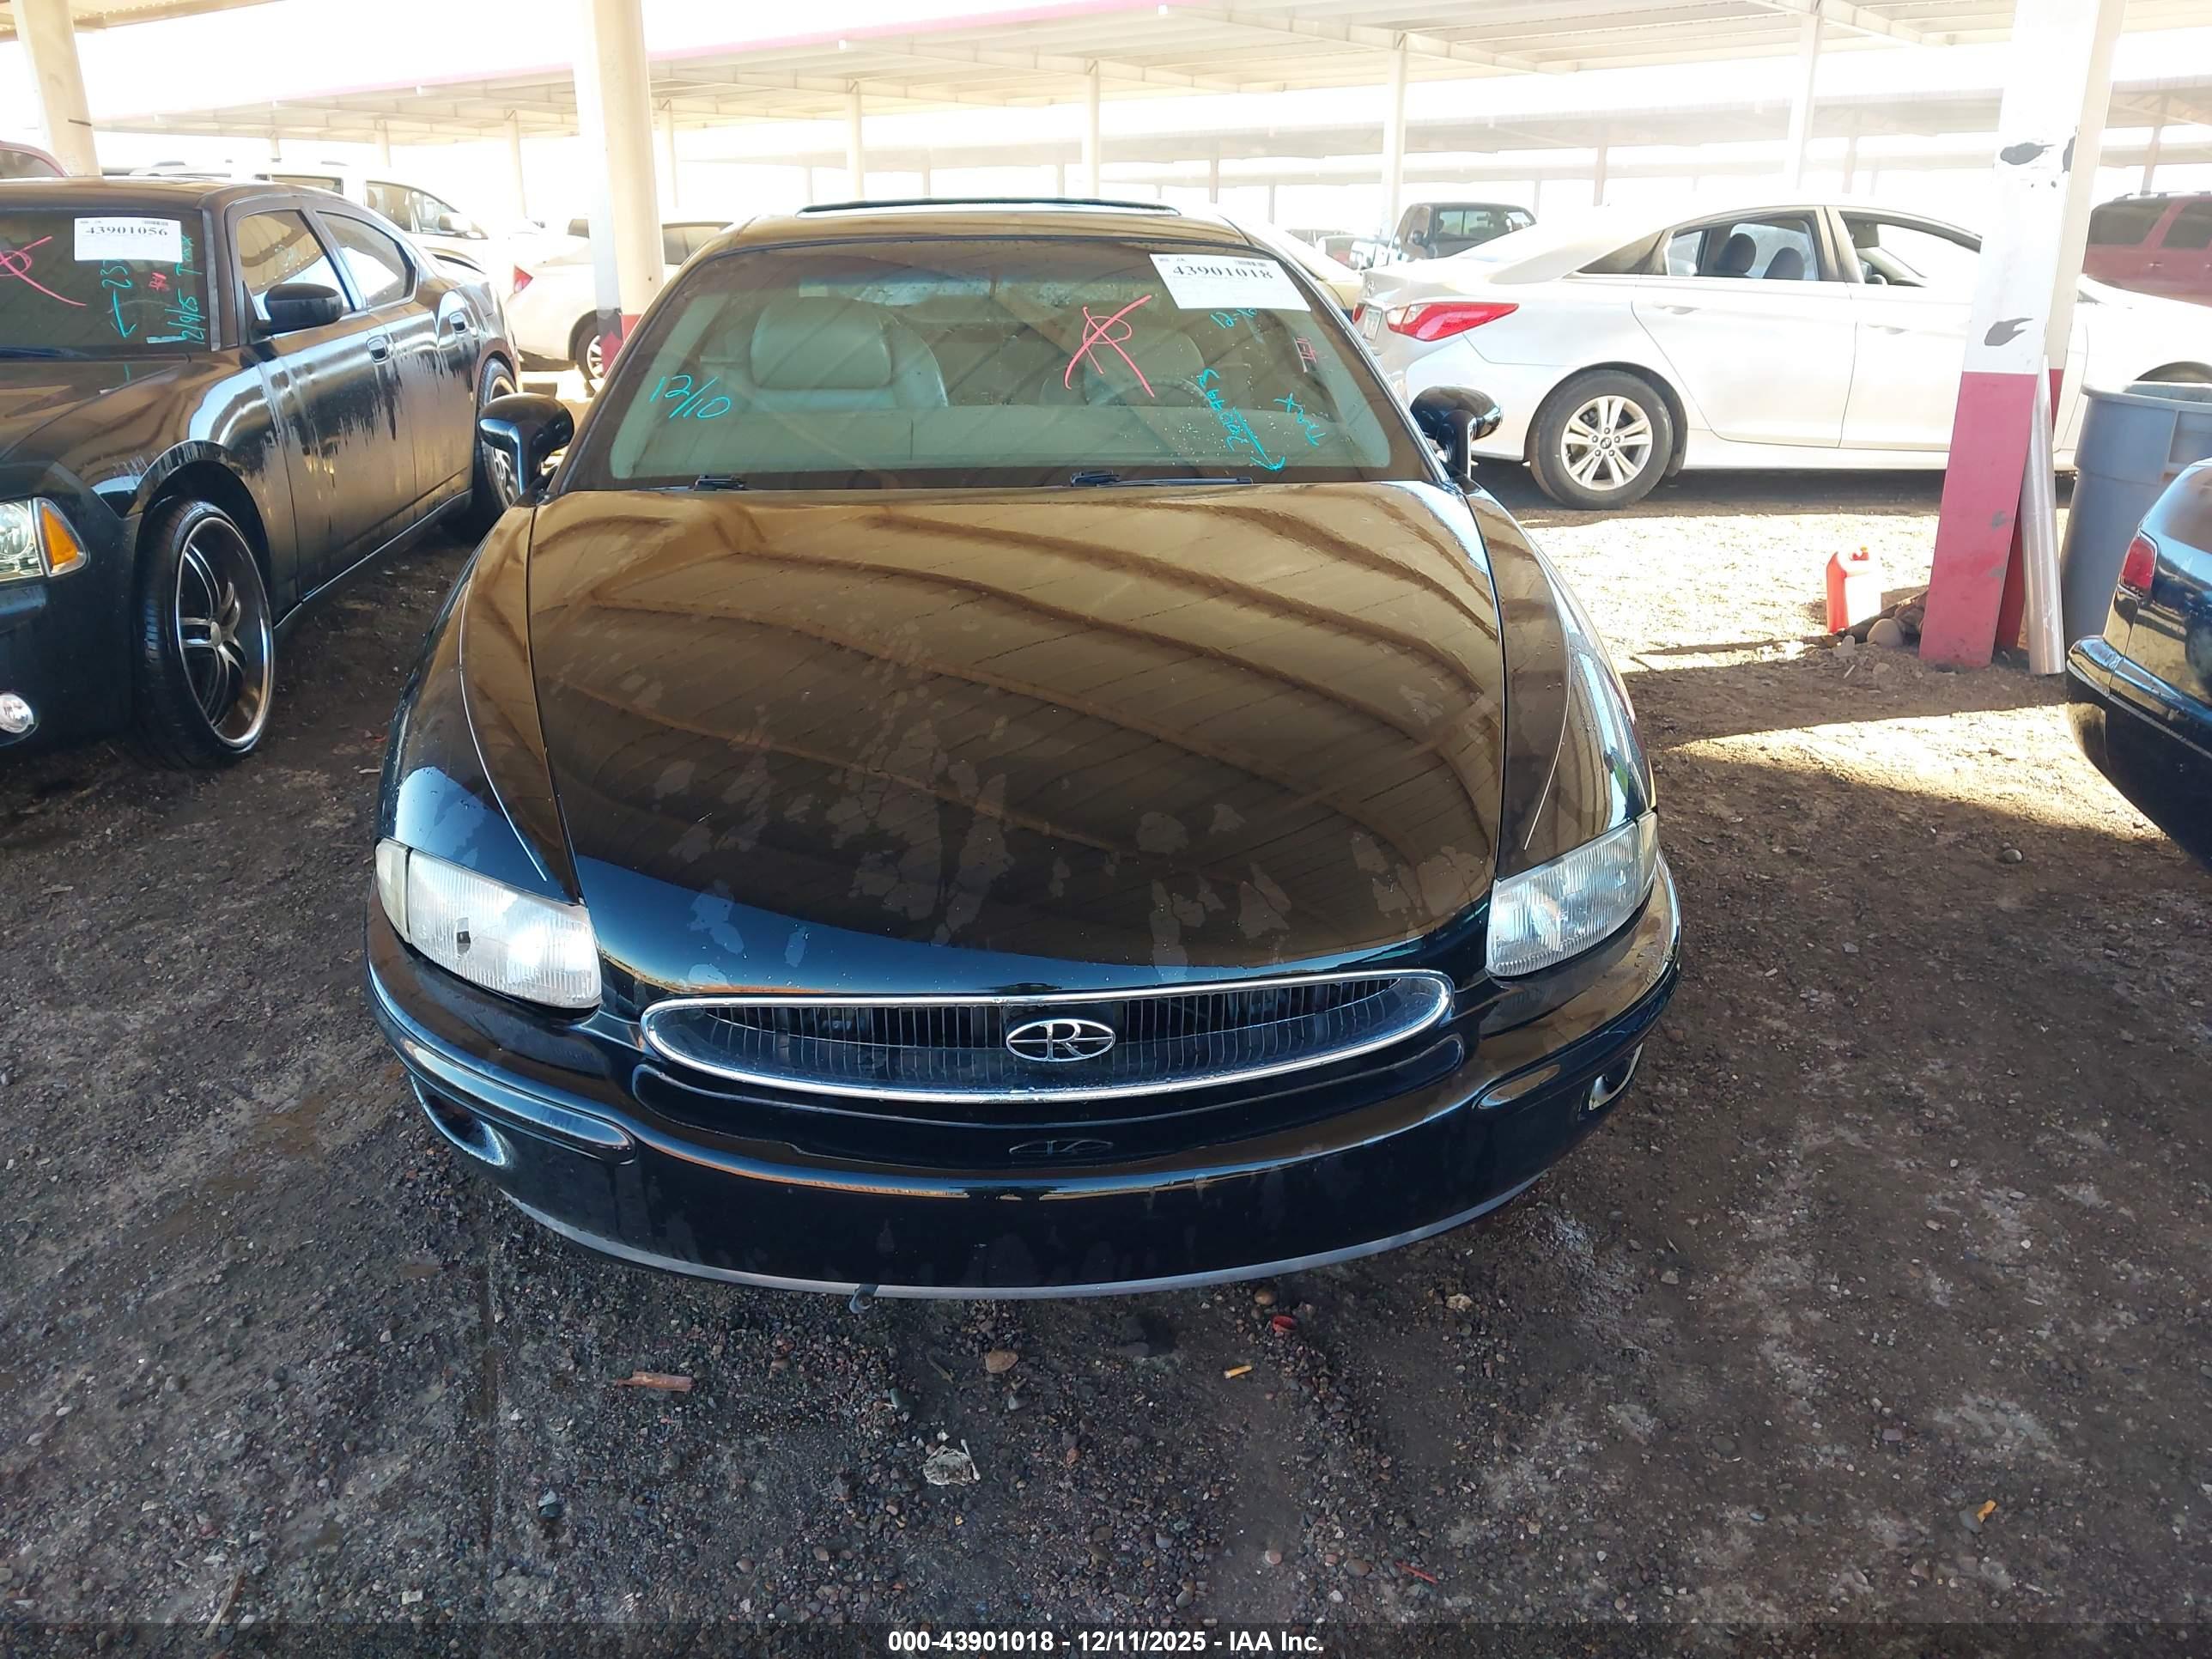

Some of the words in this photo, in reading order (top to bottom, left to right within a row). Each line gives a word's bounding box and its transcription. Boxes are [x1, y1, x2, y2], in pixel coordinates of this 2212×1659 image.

[84, 225, 169, 237] 43901056
[1172, 265, 1273, 279] 43901018
[648, 374, 731, 419] 12/10
